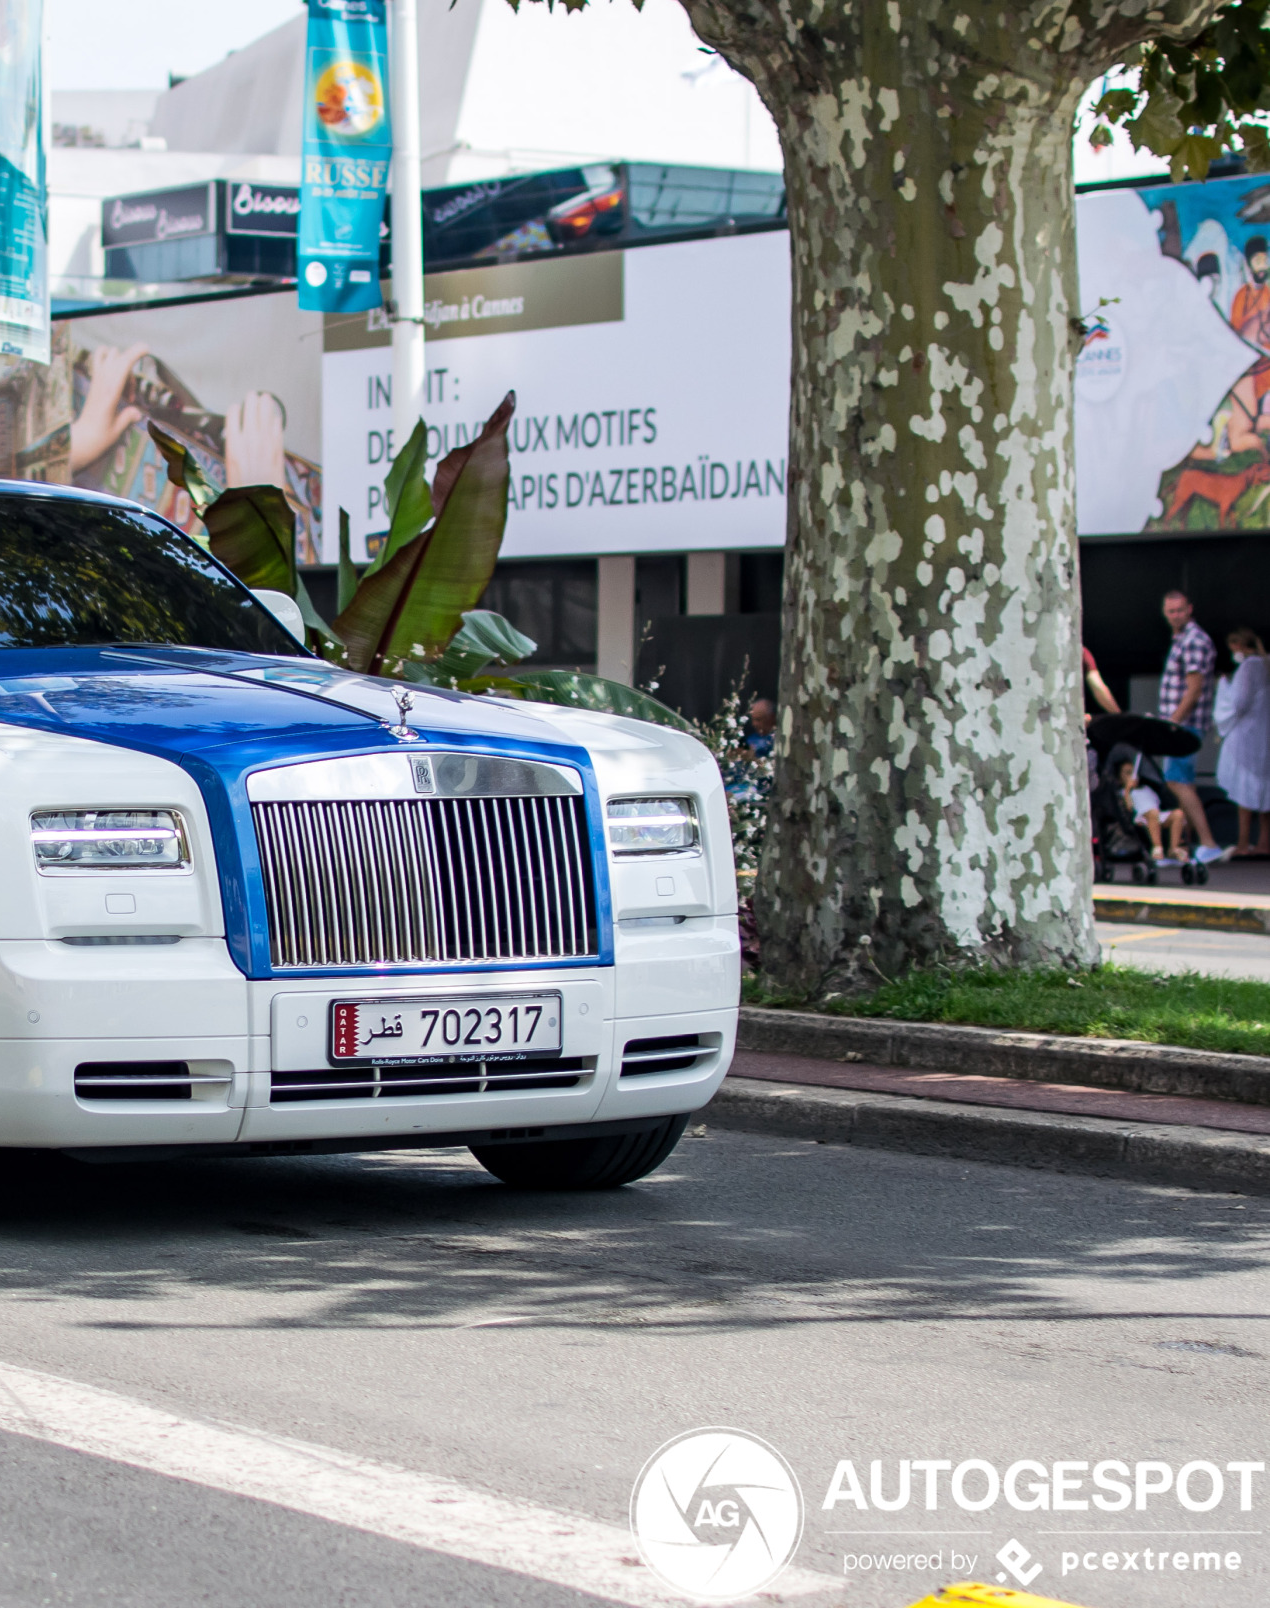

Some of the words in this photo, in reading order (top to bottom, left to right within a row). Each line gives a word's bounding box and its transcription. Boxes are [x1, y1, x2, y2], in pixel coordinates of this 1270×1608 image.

[305, 162, 387, 189] RUSSE
[234, 184, 301, 215] Bisou
[472, 294, 524, 319] Cannes
[368, 368, 448, 409] INIT
[427, 415, 549, 460] OUVUX
[556, 407, 657, 450] MOTIFS
[508, 472, 559, 511] APIS
[566, 454, 785, 508] D'AZERBAÏDJAN
[339, 1008, 347, 1054] QATAR
[359, 1013, 404, 1046] قطر
[420, 1005, 543, 1048] 702317
